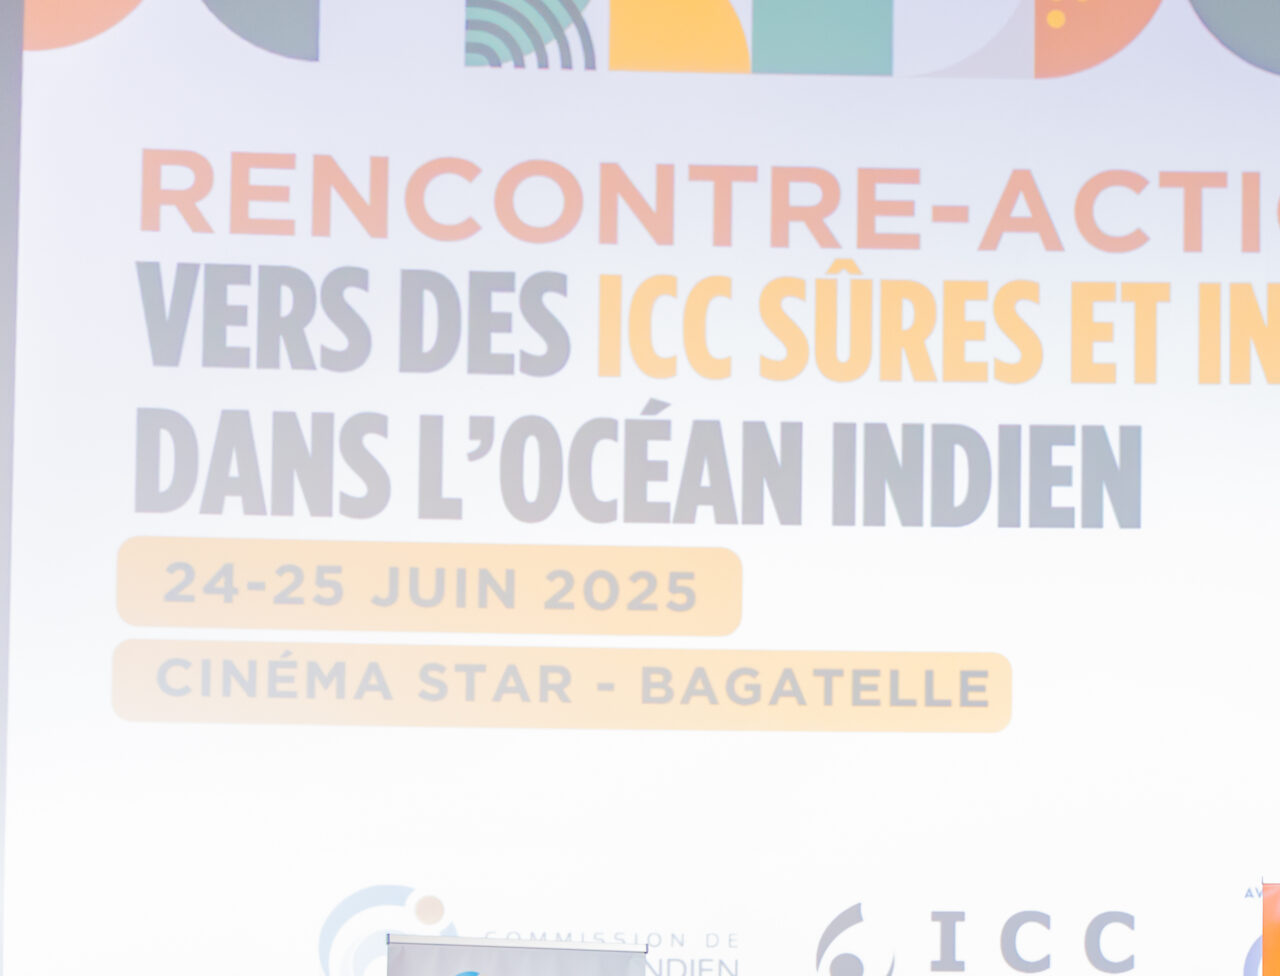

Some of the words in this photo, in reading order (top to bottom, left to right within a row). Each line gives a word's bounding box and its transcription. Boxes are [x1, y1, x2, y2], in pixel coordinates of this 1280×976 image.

[135, 261, 372, 374] VERS
[399, 268, 571, 378] DES
[598, 273, 733, 380] ICC
[758, 258, 1044, 385] SÛRES
[1070, 281, 1172, 385] ET
[134, 407, 392, 520] DANS
[832, 420, 1143, 530] INDIEN
[163, 562, 346, 607] 24-25
[371, 565, 518, 610] JUIN
[544, 569, 698, 613] 2025
[156, 650, 394, 703] CINÉMA
[418, 663, 573, 704] STAR
[641, 667, 990, 708] BAGATELLE
[705, 932, 739, 948] DE
[930, 910, 1135, 974] ICC
